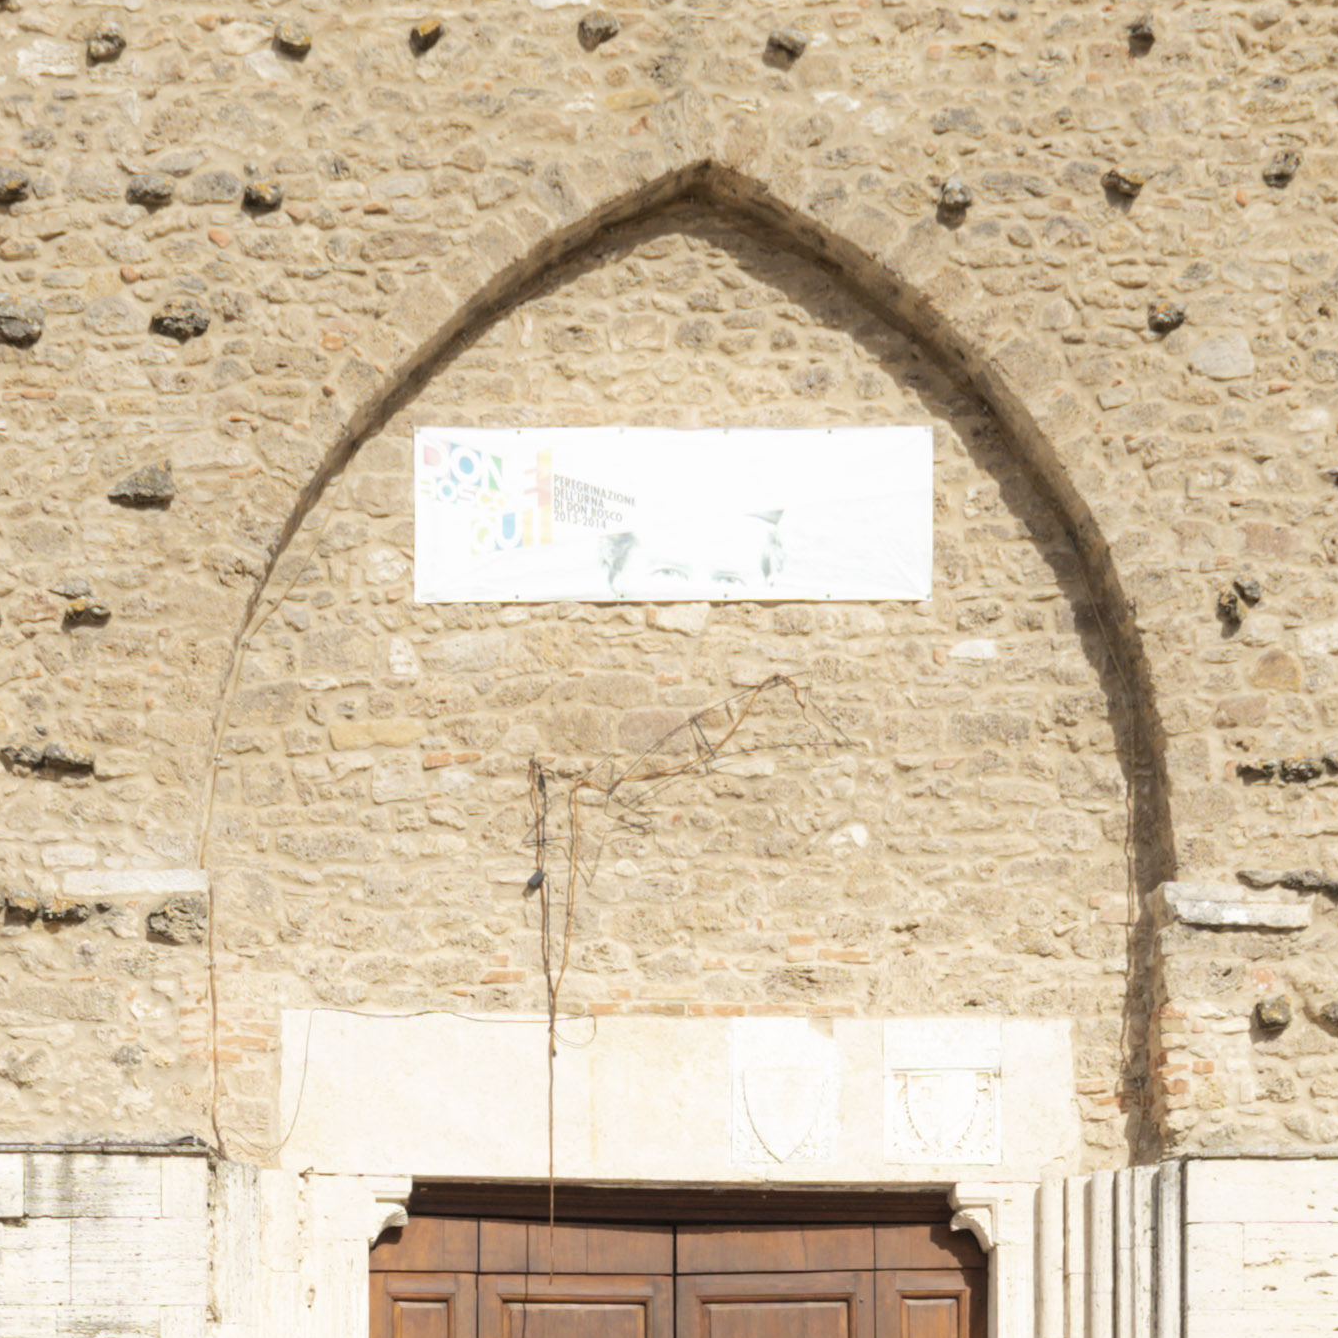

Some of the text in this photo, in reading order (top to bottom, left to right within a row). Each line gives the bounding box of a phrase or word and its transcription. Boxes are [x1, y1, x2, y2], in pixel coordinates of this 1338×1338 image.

[417, 438, 509, 495] DON
[553, 473, 637, 507] PEREGRINAZIONE
[553, 485, 605, 509] DELL'URNA
[553, 497, 623, 523] DI DON BOSCO
[553, 509, 606, 530] 2013-2014
